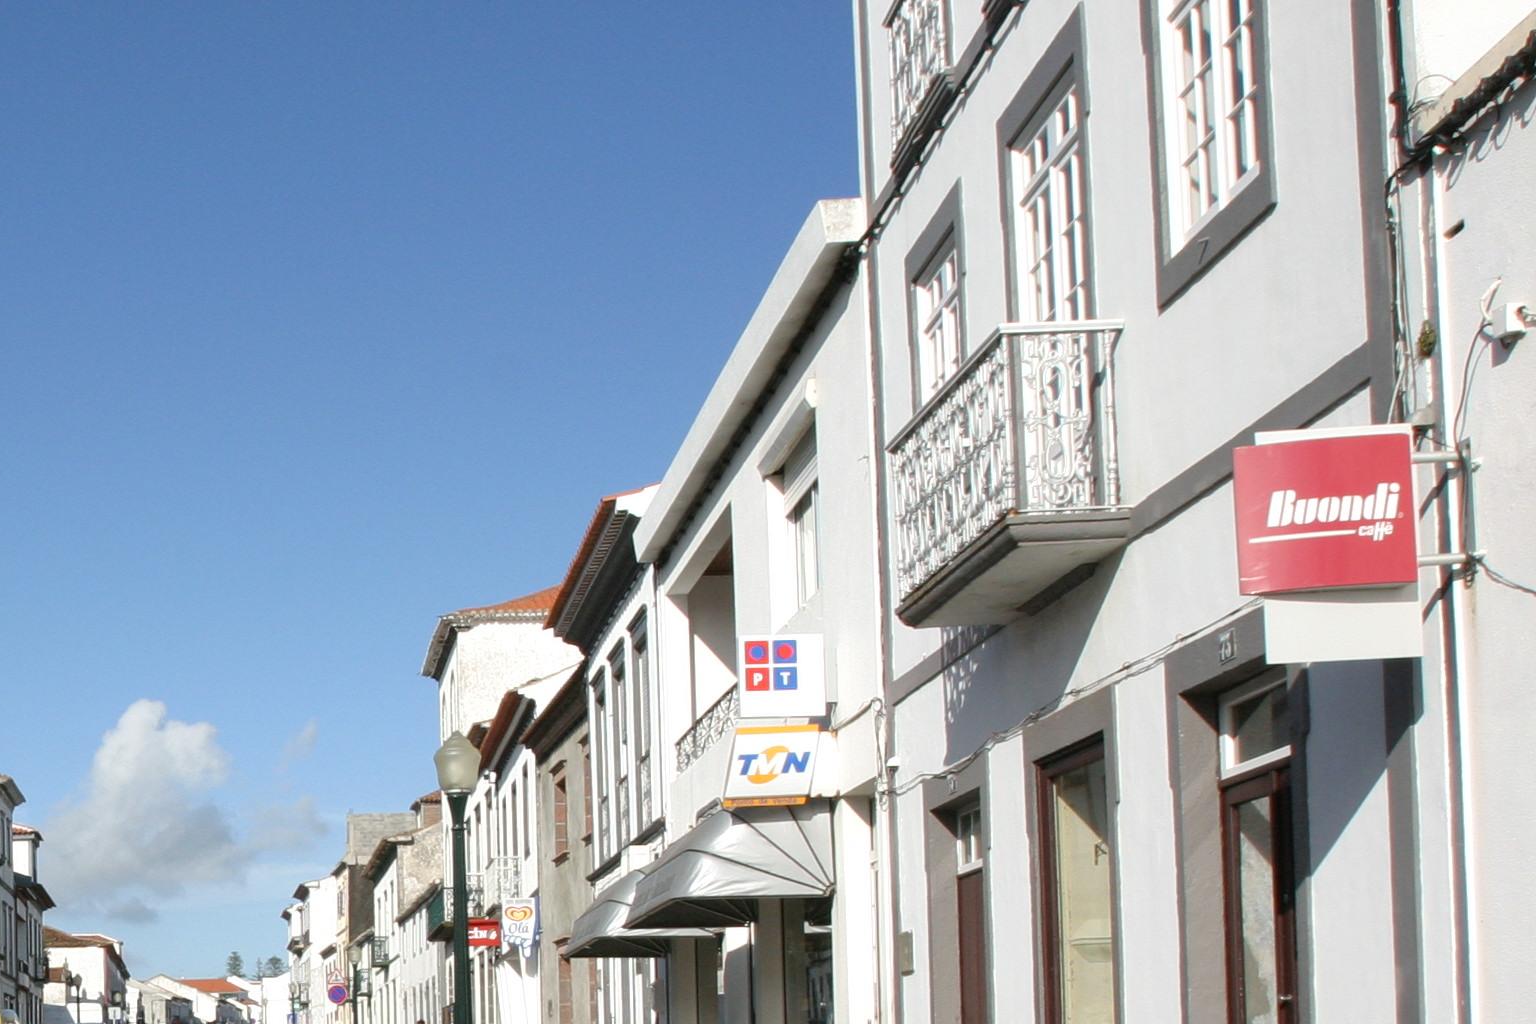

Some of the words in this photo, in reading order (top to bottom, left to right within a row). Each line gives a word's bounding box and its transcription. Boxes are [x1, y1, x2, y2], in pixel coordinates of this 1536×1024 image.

[1267, 482, 1400, 527] Buondi
[738, 752, 811, 775] TMN
[508, 922, 529, 934] Olá
